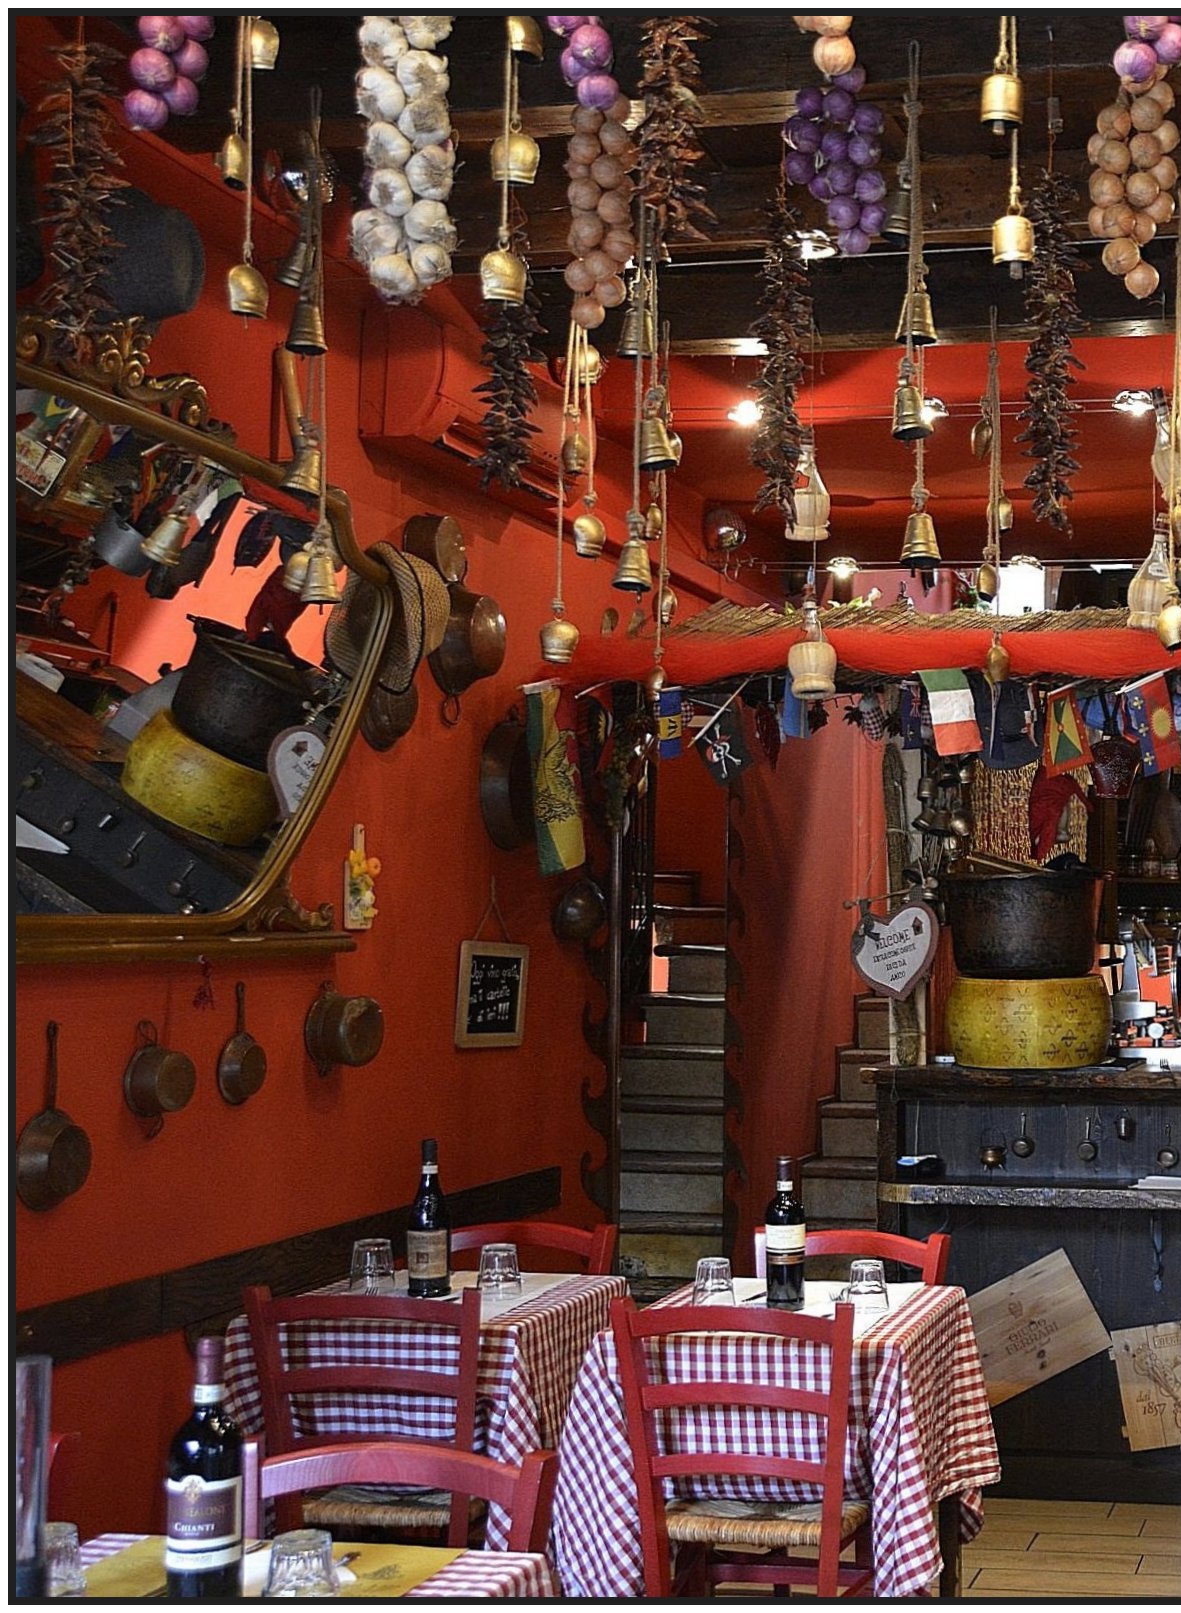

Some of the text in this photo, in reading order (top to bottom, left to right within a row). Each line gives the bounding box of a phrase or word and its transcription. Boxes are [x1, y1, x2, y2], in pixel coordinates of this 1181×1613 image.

[875, 928, 911, 951] WELCOME
[1005, 1321, 1059, 1357] FERRARI
[1143, 1401, 1168, 1417] 1857
[174, 1522, 216, 1533] CHIANTI
